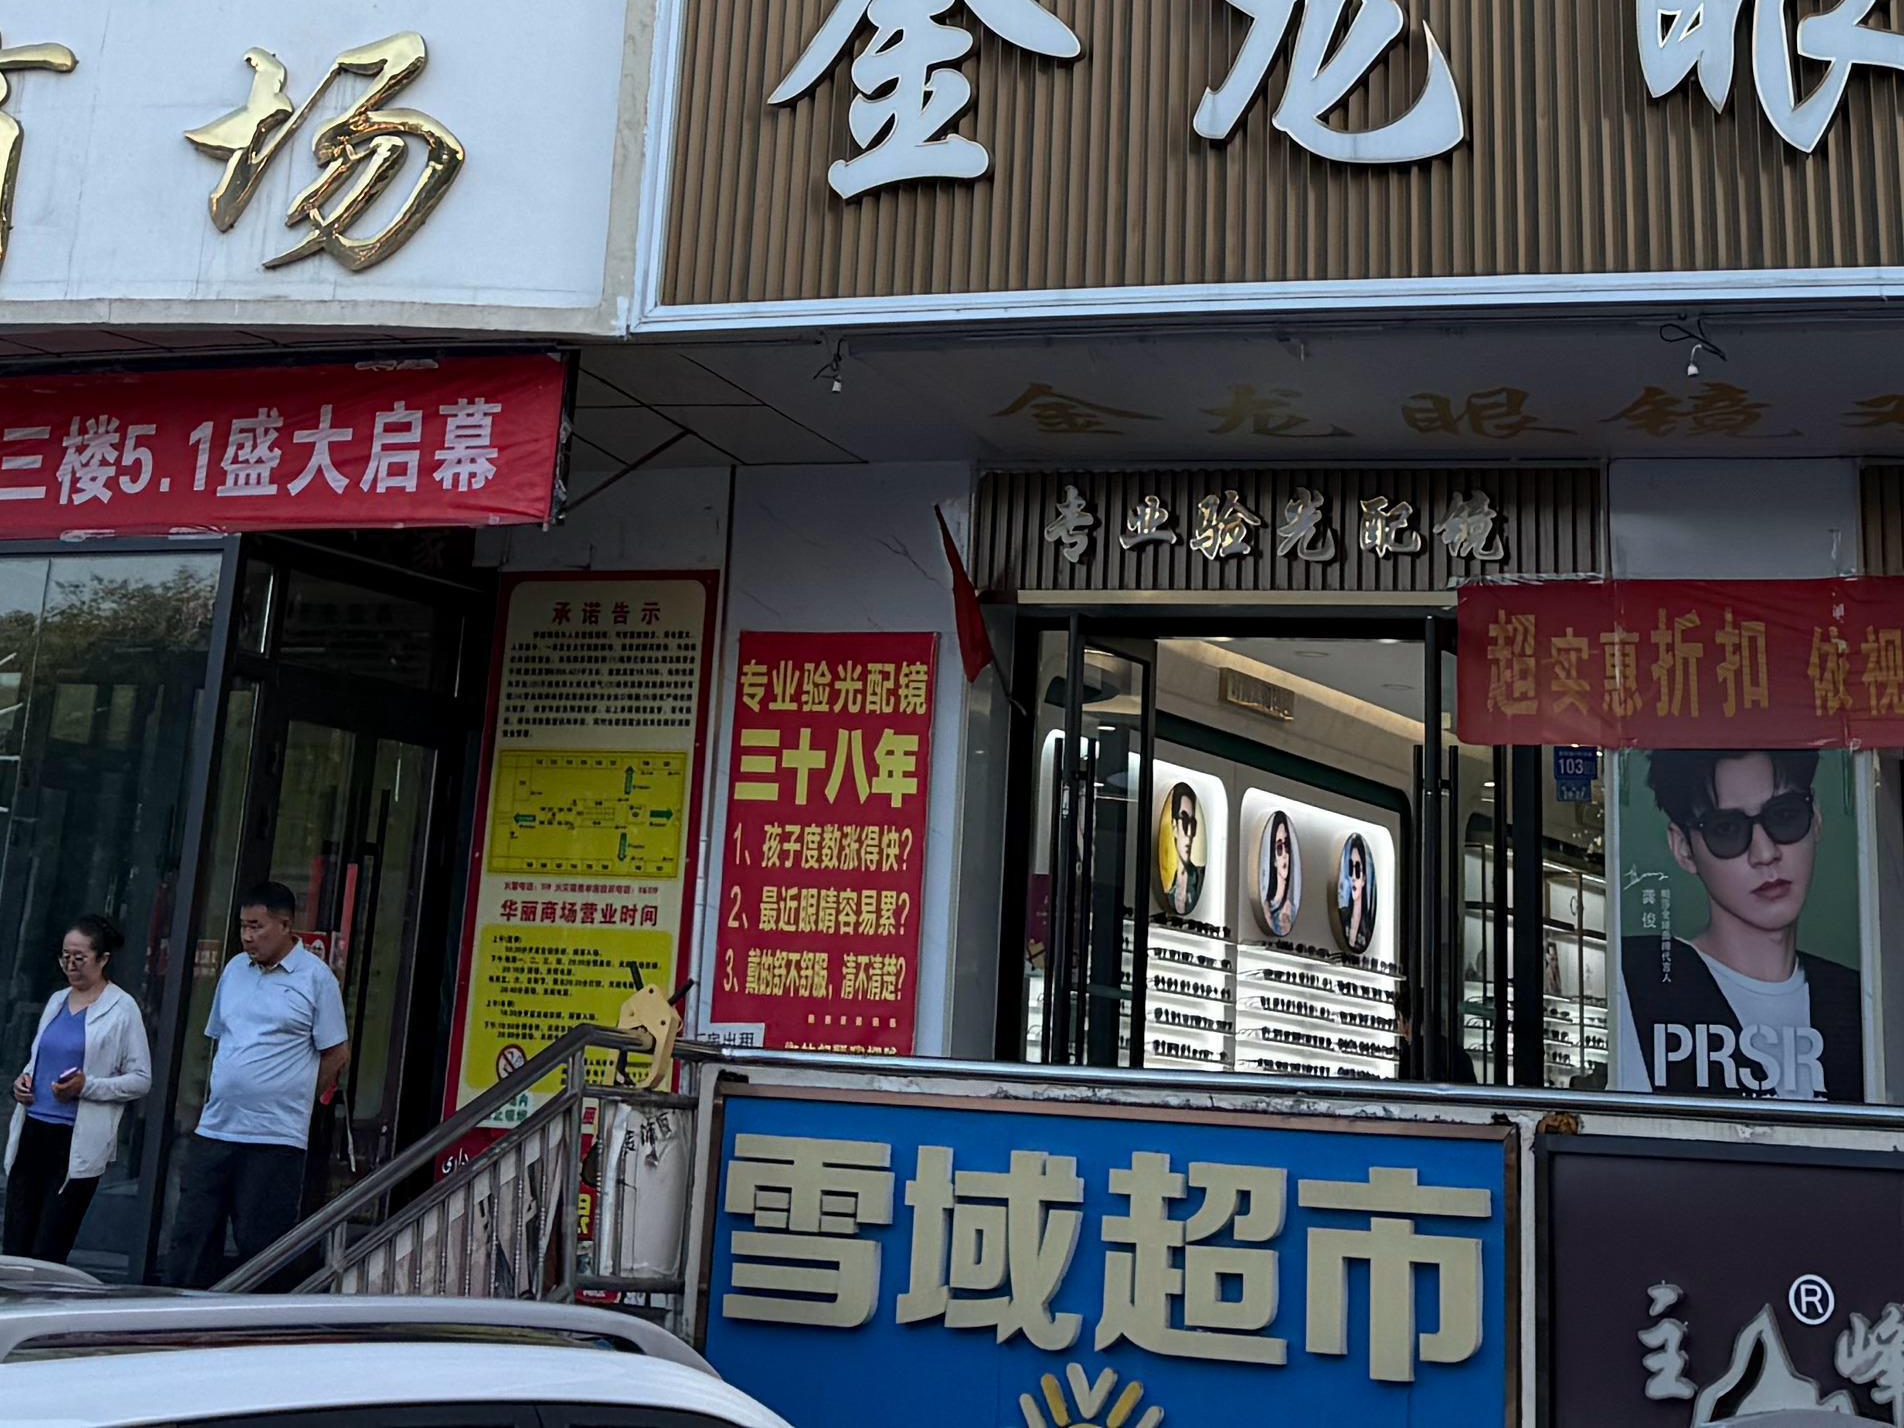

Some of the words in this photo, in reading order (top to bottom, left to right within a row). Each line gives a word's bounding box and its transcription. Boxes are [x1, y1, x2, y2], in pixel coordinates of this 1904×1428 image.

[1041, 487, 1509, 564] 专业验光配镜
[552, 601, 661, 625] 承诺告示
[741, 659, 928, 715] 专业验光配镜
[1487, 607, 1769, 717] 超实惠折扣
[734, 727, 919, 808] 三十八年
[733, 822, 912, 872] 1、孩子度数涨得快?
[500, 899, 658, 927] 华丽商场营业时间
[728, 885, 909, 936] 2、最近眼睛容易累?
[1654, 1023, 1825, 1090] PRSR
[721, 1132, 1492, 1384] 雪域超市
